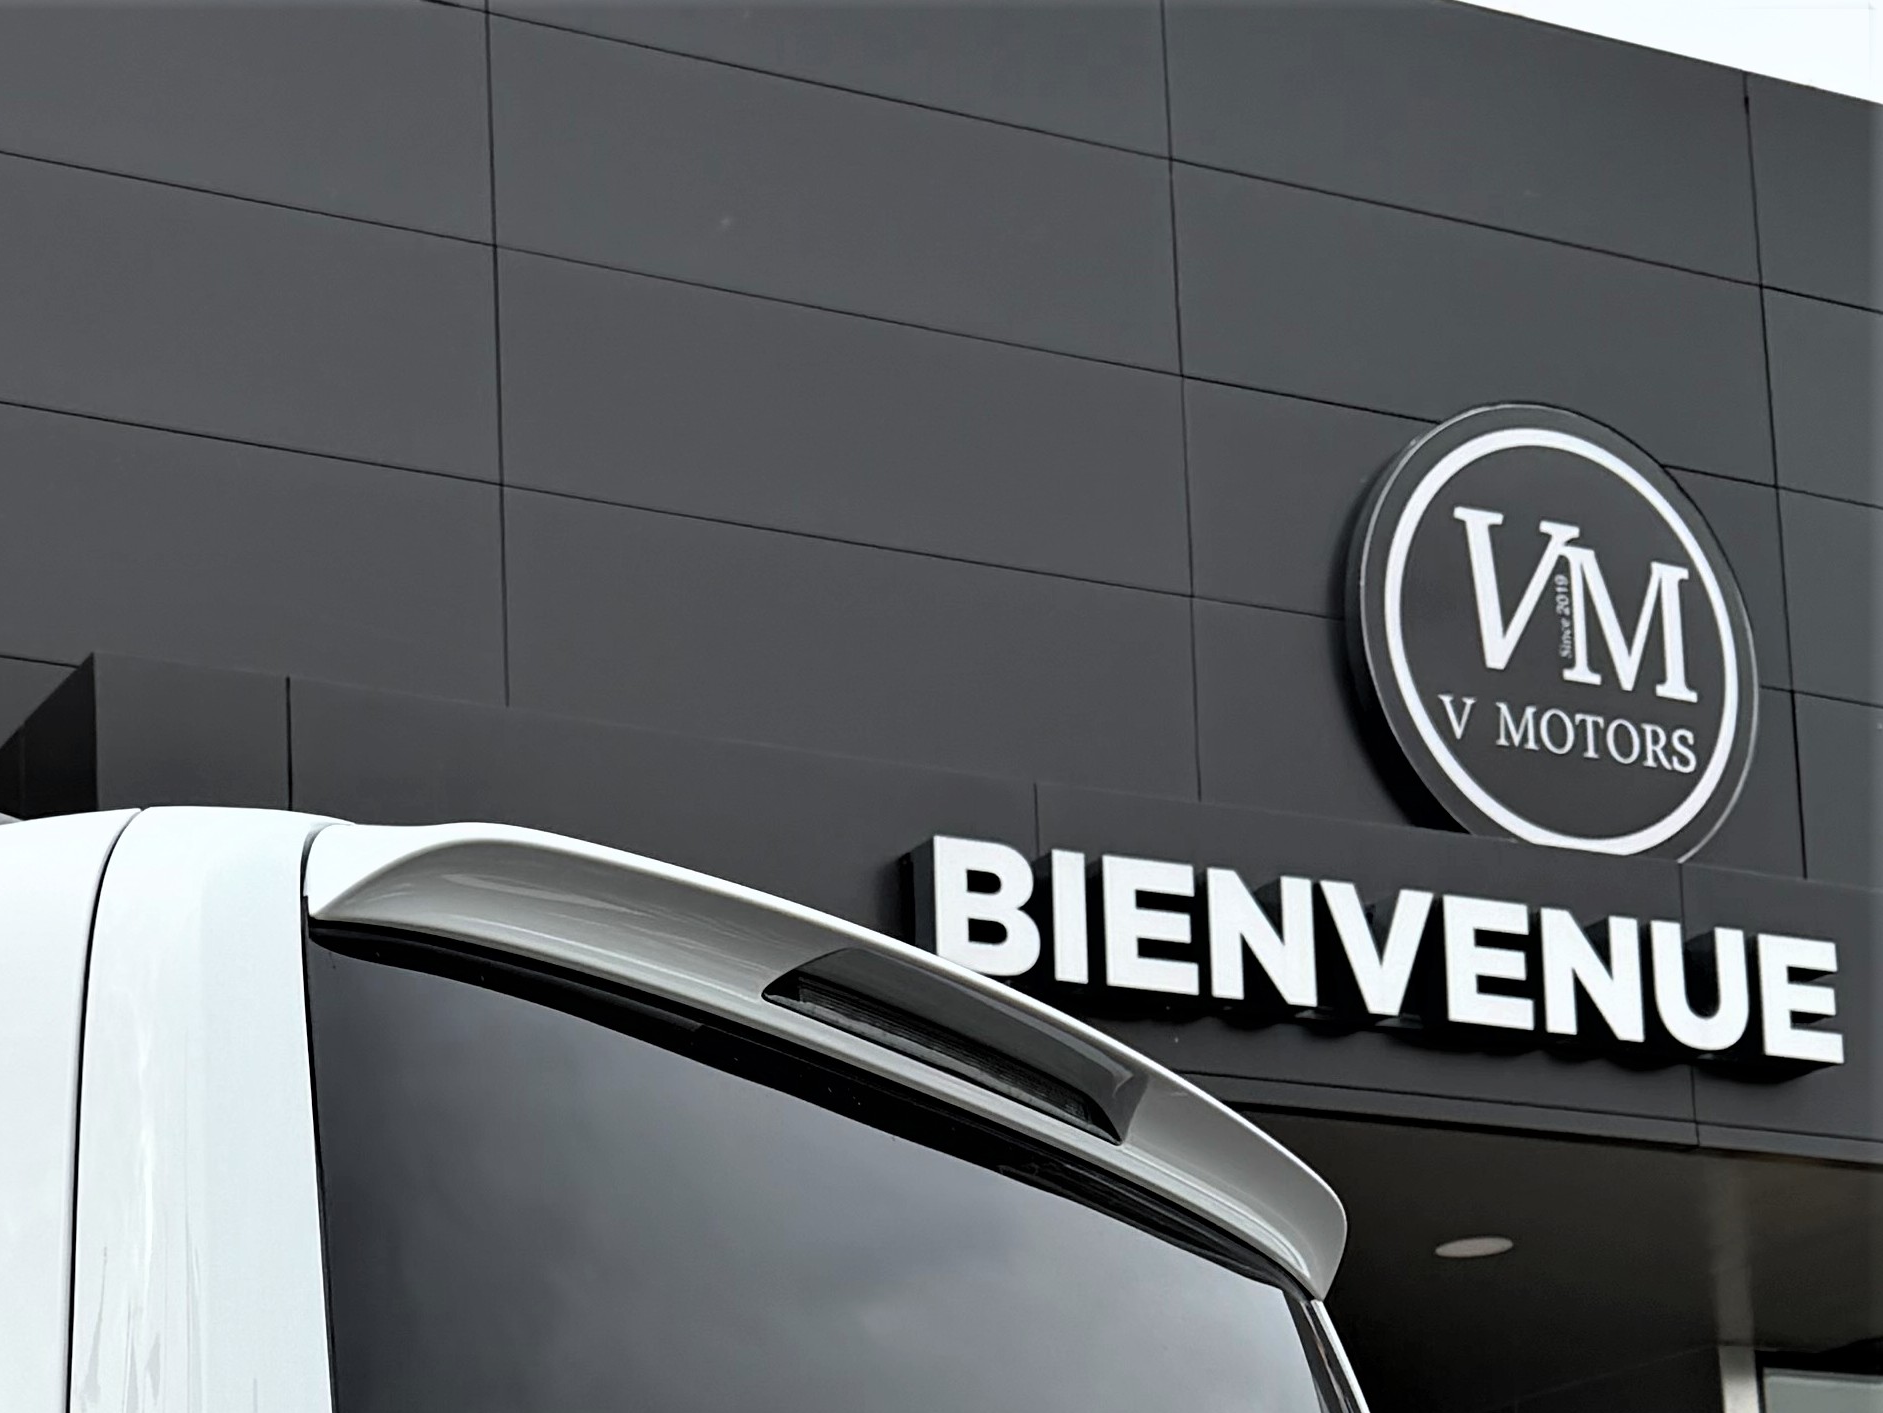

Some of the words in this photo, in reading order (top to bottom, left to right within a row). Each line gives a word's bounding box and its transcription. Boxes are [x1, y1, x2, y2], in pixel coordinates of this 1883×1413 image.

[1453, 505, 1698, 703] VM
[1556, 573, 1569, 615] 2019
[1559, 616, 1573, 659] Since
[1438, 694, 1477, 740] V
[1496, 701, 1697, 774] MOTORS
[932, 834, 1845, 1064] BIENVENUE
